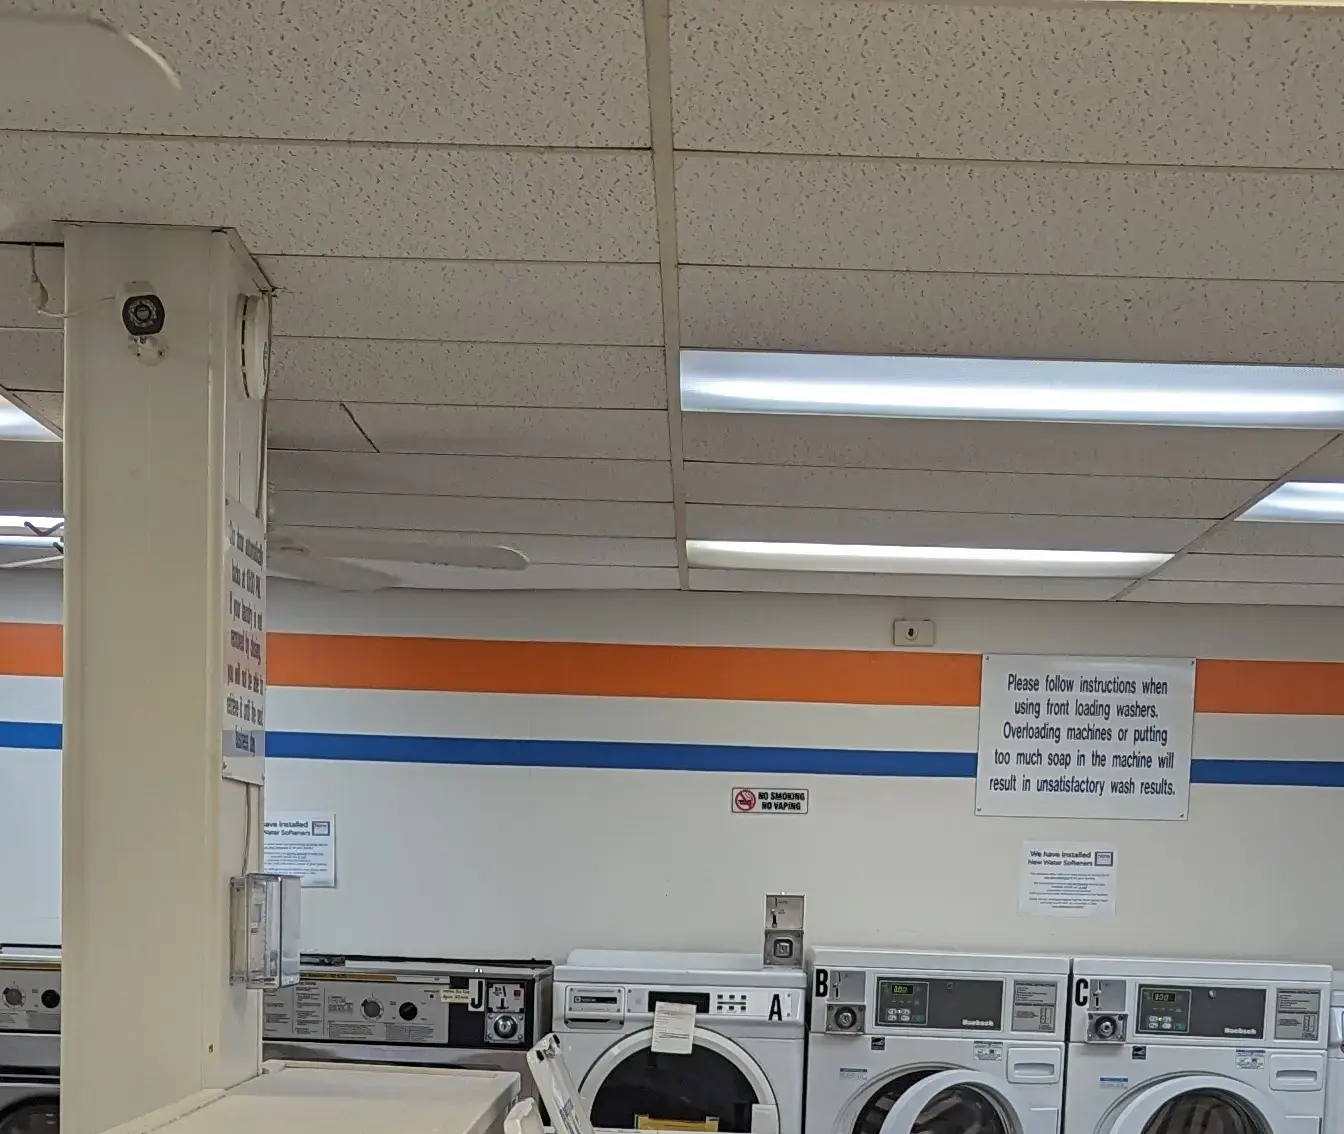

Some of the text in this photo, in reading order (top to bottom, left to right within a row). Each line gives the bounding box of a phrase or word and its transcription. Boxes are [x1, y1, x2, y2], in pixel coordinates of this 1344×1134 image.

[1008, 673, 1168, 695] Please follow instructions when
[1014, 698, 1158, 720] using front loading washers.
[1003, 721, 1168, 746] Overloading machines or putting
[994, 749, 1175, 769] too much soap in the machine will
[989, 774, 1176, 796] result in unsatisfactory wash results.
[758, 792, 805, 801] NO SMOKING
[761, 802, 801, 810] NO VAPING
[815, 969, 828, 997] B
[1075, 978, 1088, 1006] C
[471, 980, 483, 1009] J
[768, 993, 783, 1021] A
